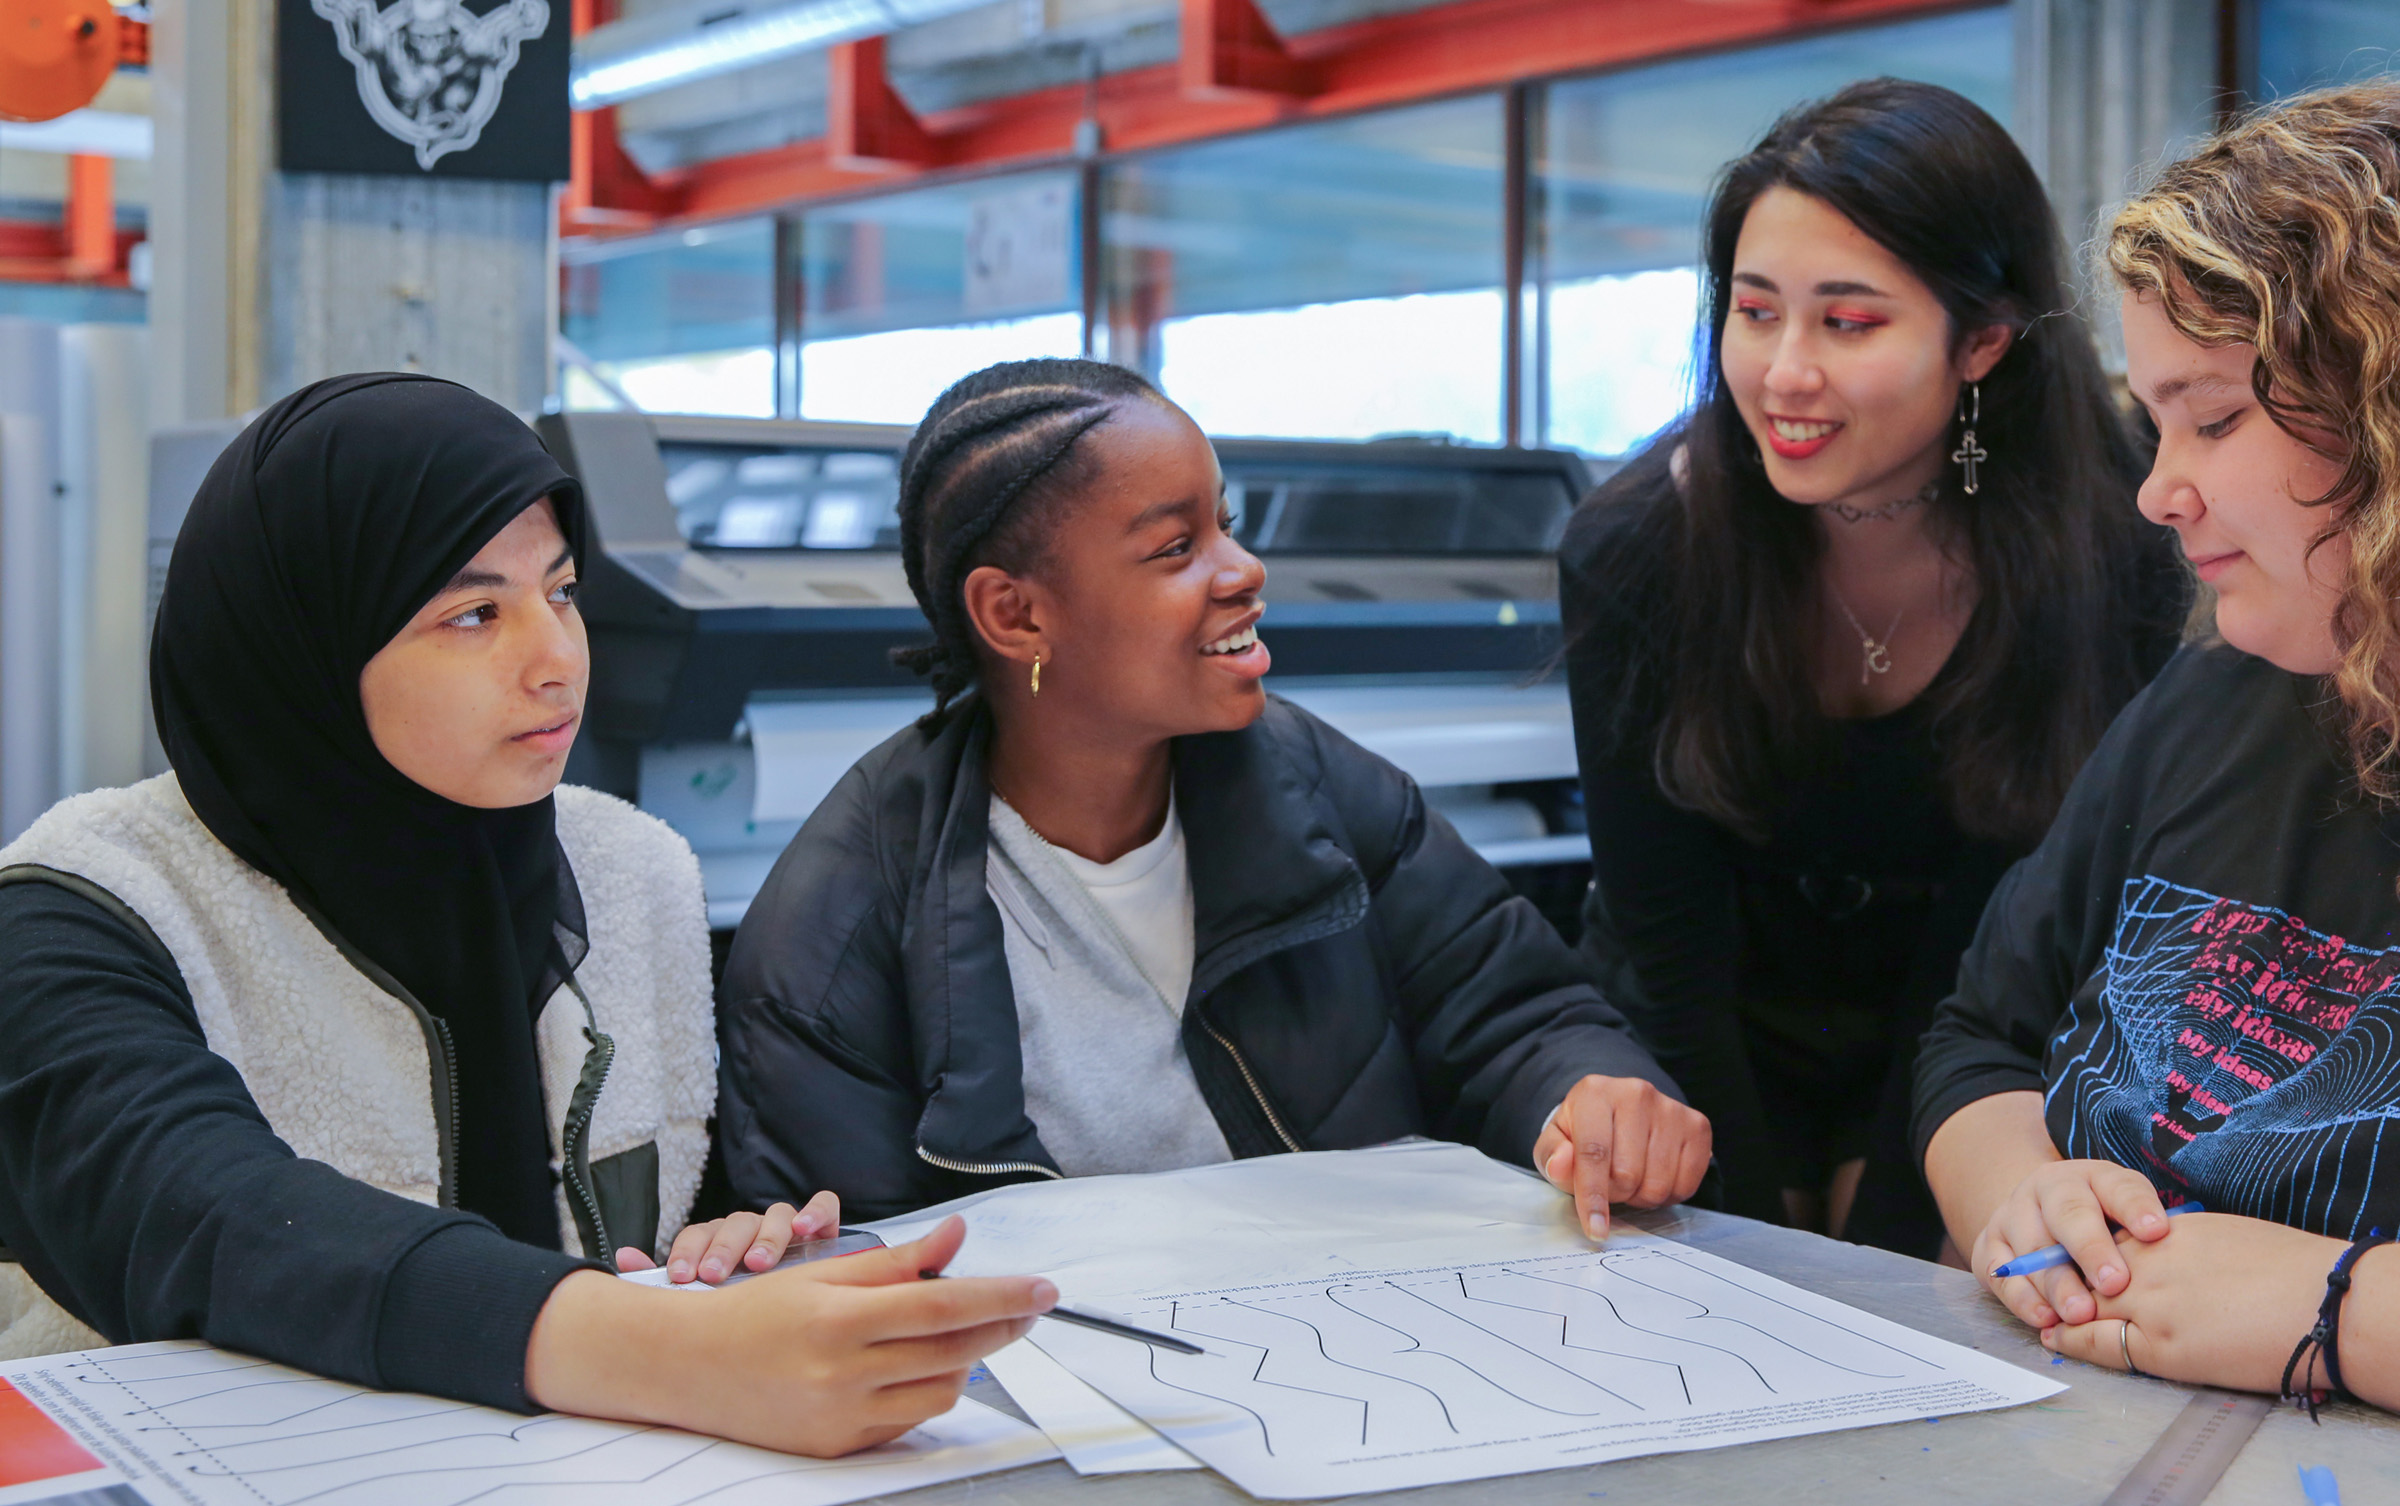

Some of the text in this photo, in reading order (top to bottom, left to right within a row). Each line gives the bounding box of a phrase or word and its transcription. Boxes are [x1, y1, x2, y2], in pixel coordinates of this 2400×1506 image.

[2177, 1027, 2274, 1091] My ideas
[2165, 1069, 2234, 1116] My ideas
[2151, 1111, 2198, 1143] My ideas
[1208, 1285, 1262, 1296] backing
